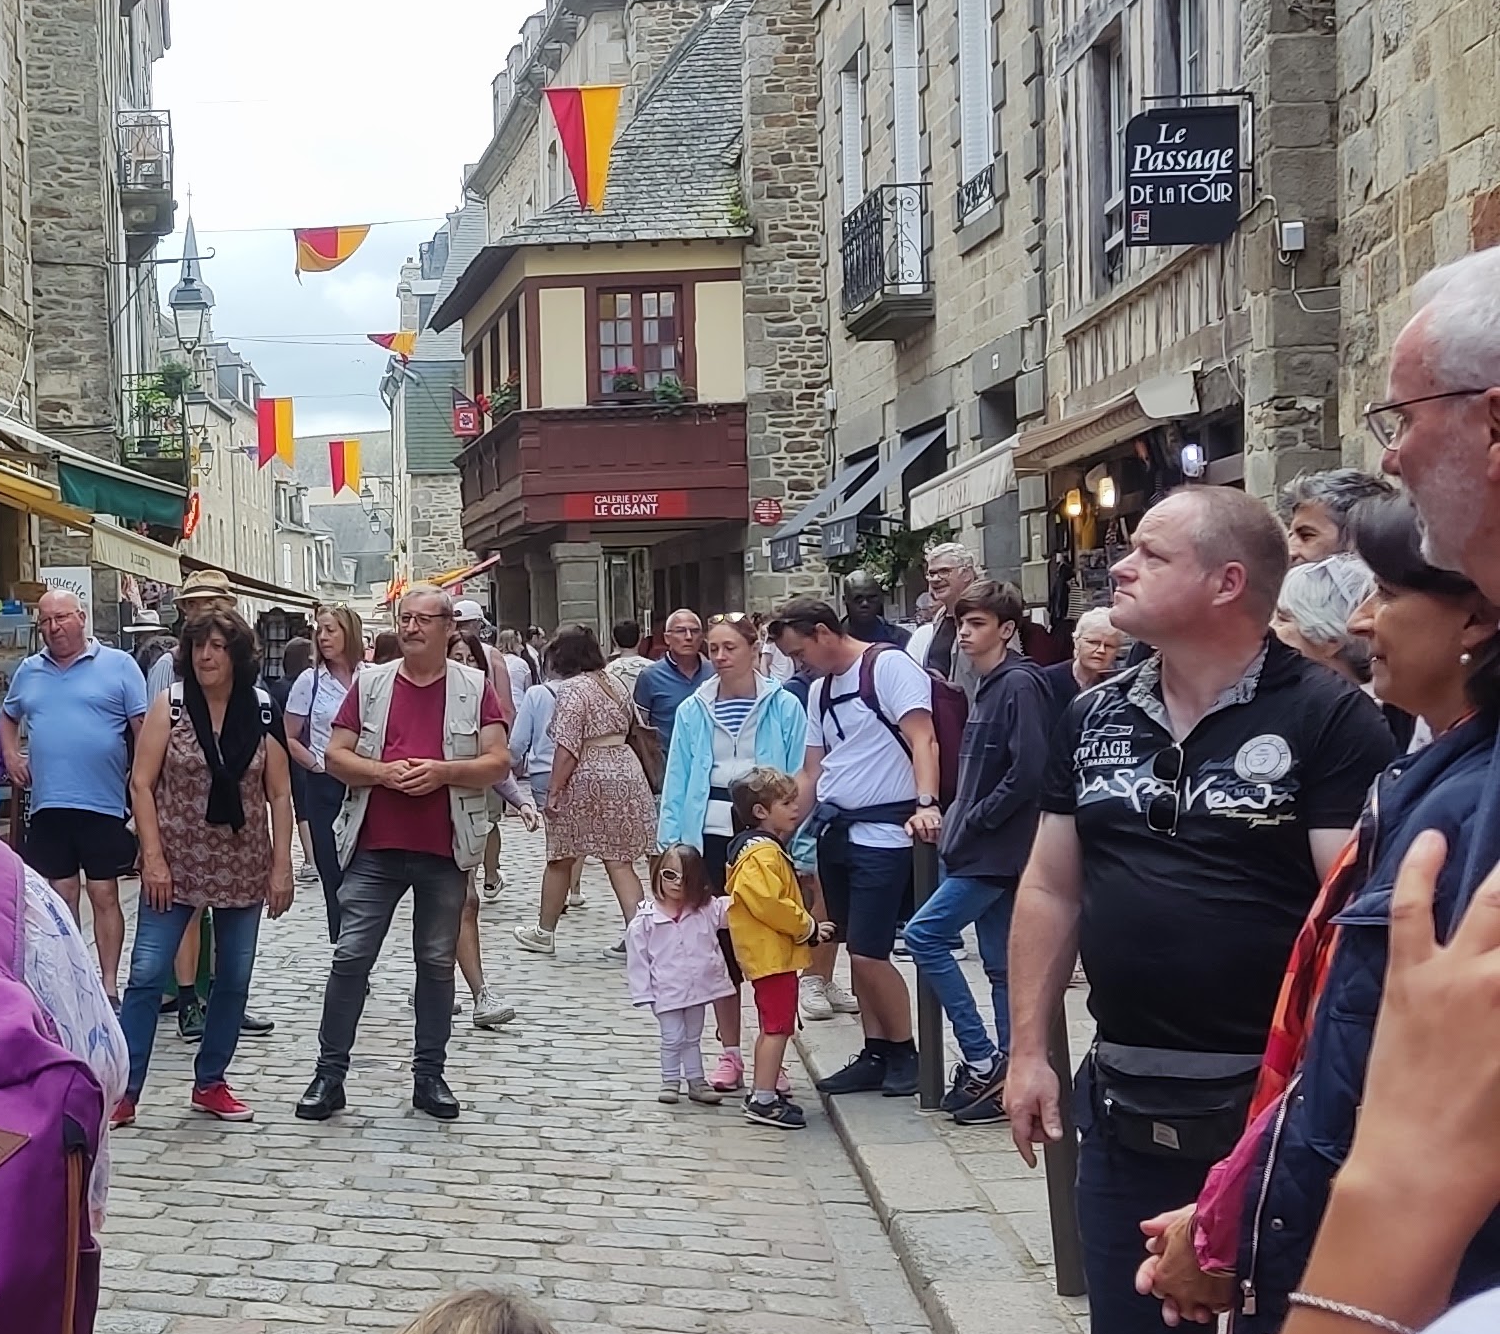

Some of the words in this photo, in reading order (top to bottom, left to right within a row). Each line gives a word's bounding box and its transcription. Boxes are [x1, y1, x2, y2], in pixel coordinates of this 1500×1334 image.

[1156, 122, 1187, 144] Le
[1131, 144, 1234, 182] Passage
[1130, 184, 1154, 204] DE
[1159, 186, 1175, 204] LA
[1178, 182, 1233, 204] TOUR
[594, 494, 630, 505] GALERIE
[631, 493, 659, 504] D'ART
[594, 504, 609, 516] LE
[610, 503, 659, 516] GISANT
[40, 575, 86, 600] inguette
